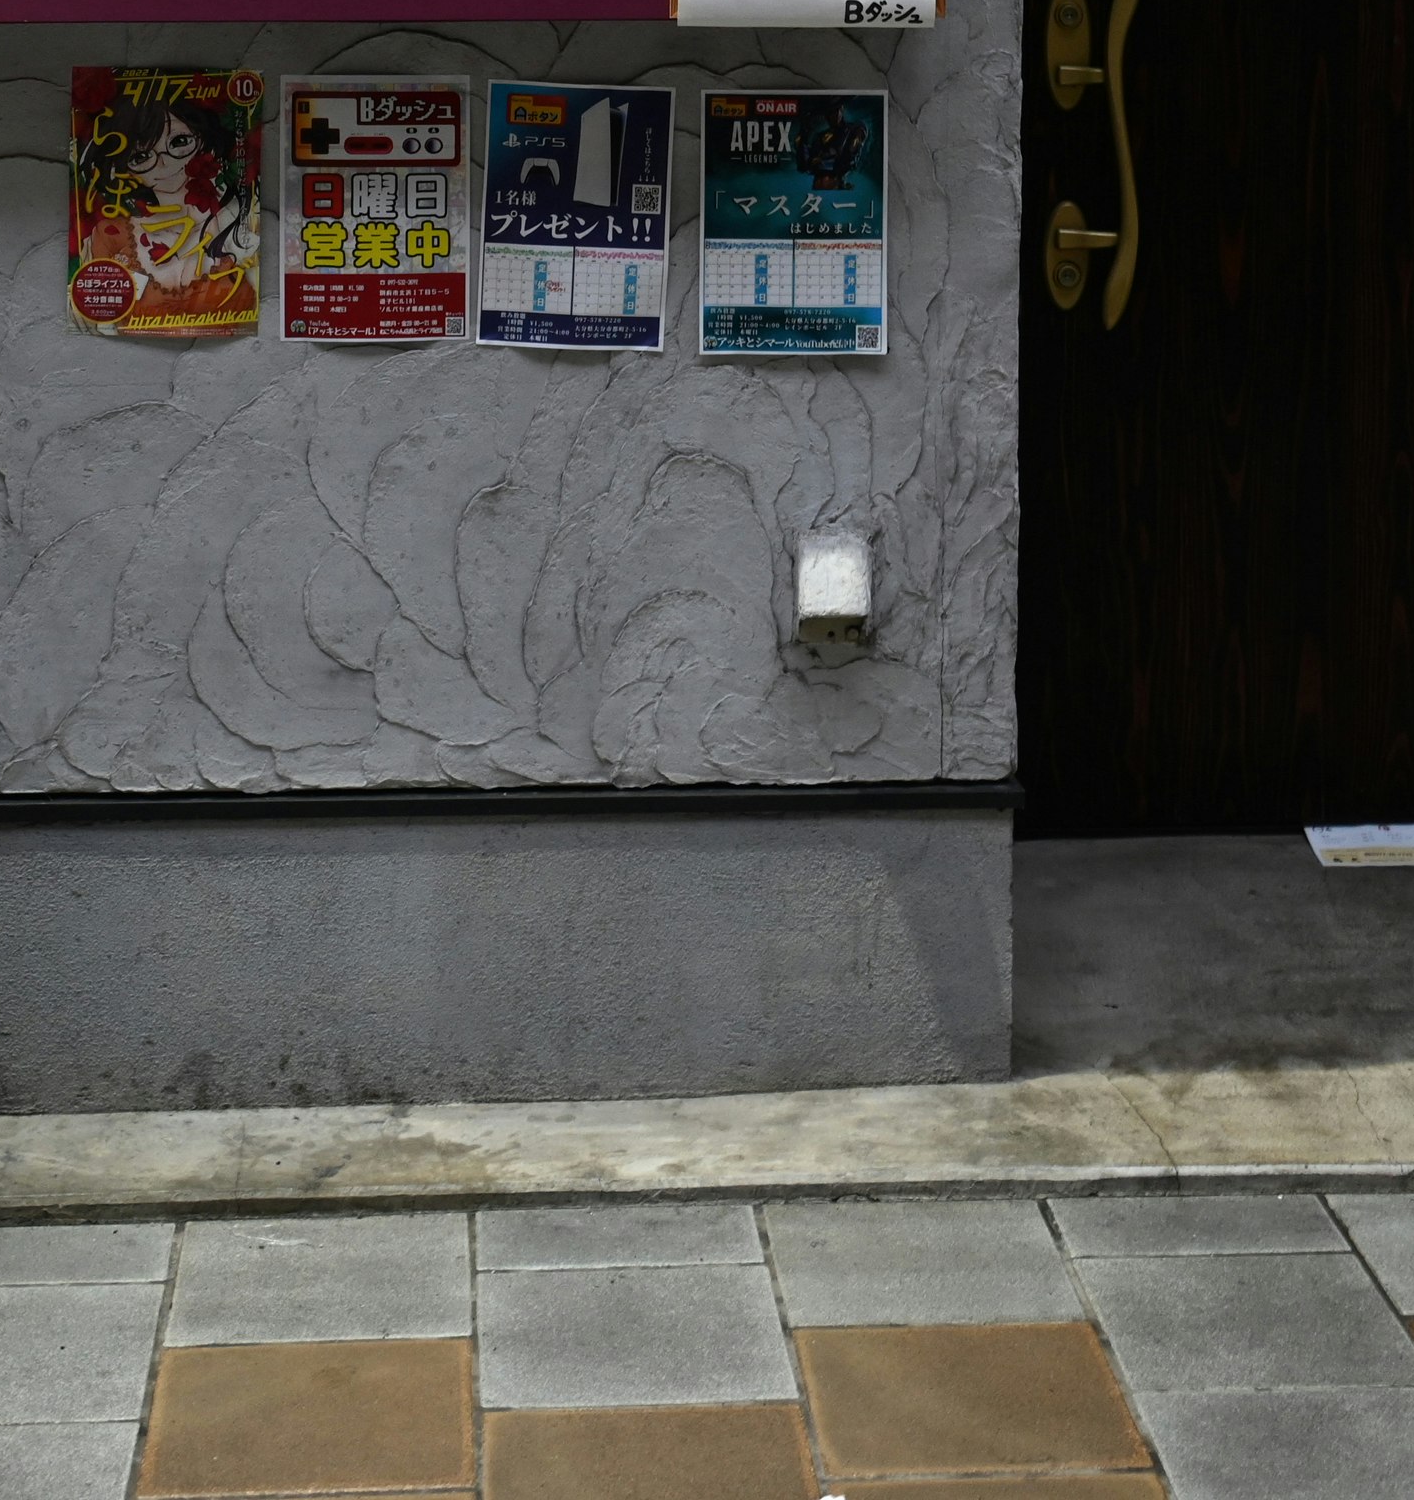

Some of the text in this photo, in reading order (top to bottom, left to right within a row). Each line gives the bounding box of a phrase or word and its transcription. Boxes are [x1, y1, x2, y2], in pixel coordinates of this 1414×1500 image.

[844, 0, 924, 24] Bダッシュ
[360, 96, 456, 123] Bダッシュ
[756, 102, 798, 114] ON AIR
[525, 136, 567, 148] PS5
[730, 120, 792, 152] APEX
[744, 154, 778, 164] LEGENDS
[301, 173, 448, 220] 日曜日
[495, 190, 537, 207] 1名様
[301, 220, 453, 270] 営業中
